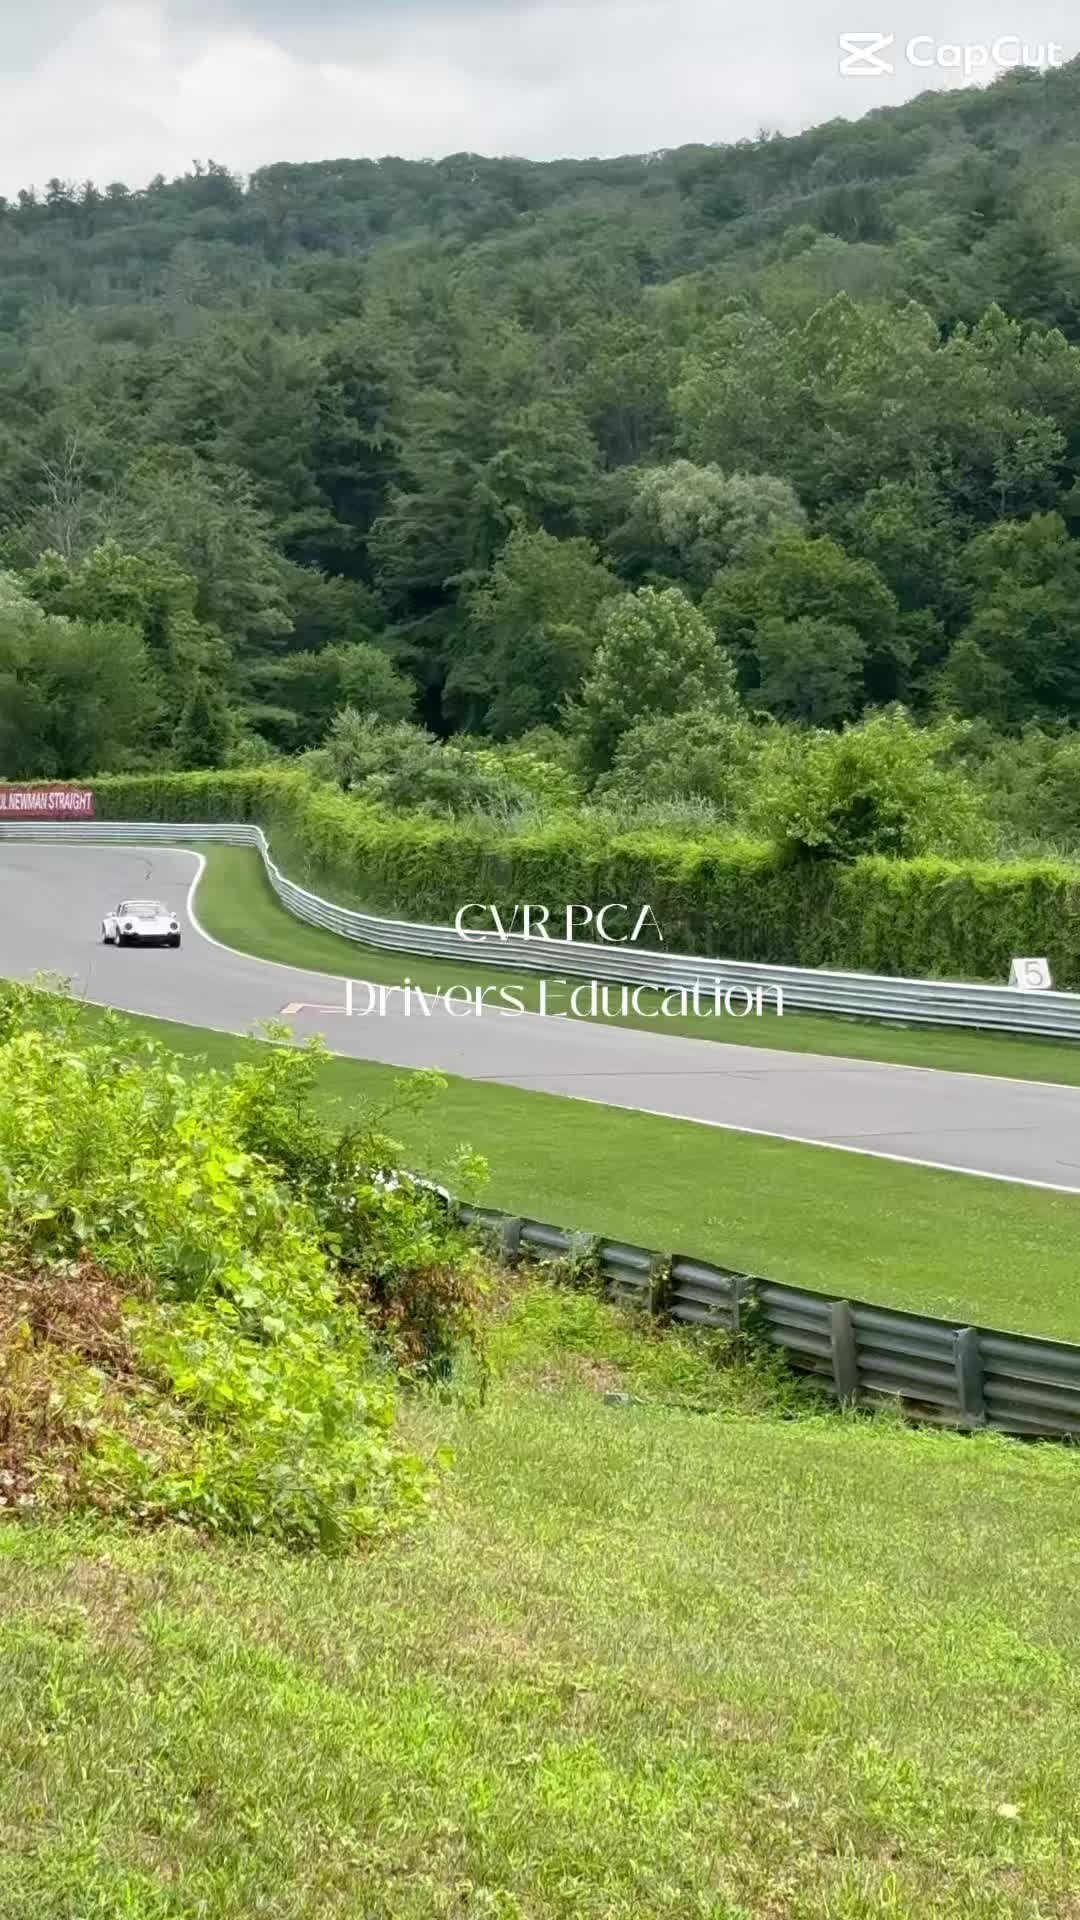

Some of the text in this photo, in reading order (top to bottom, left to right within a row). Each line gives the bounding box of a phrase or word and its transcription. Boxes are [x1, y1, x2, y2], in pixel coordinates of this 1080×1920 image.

[9, 792, 47, 810] NEWMAN
[49, 792, 92, 810] STRAIGHT
[1024, 961, 1043, 986] 5
